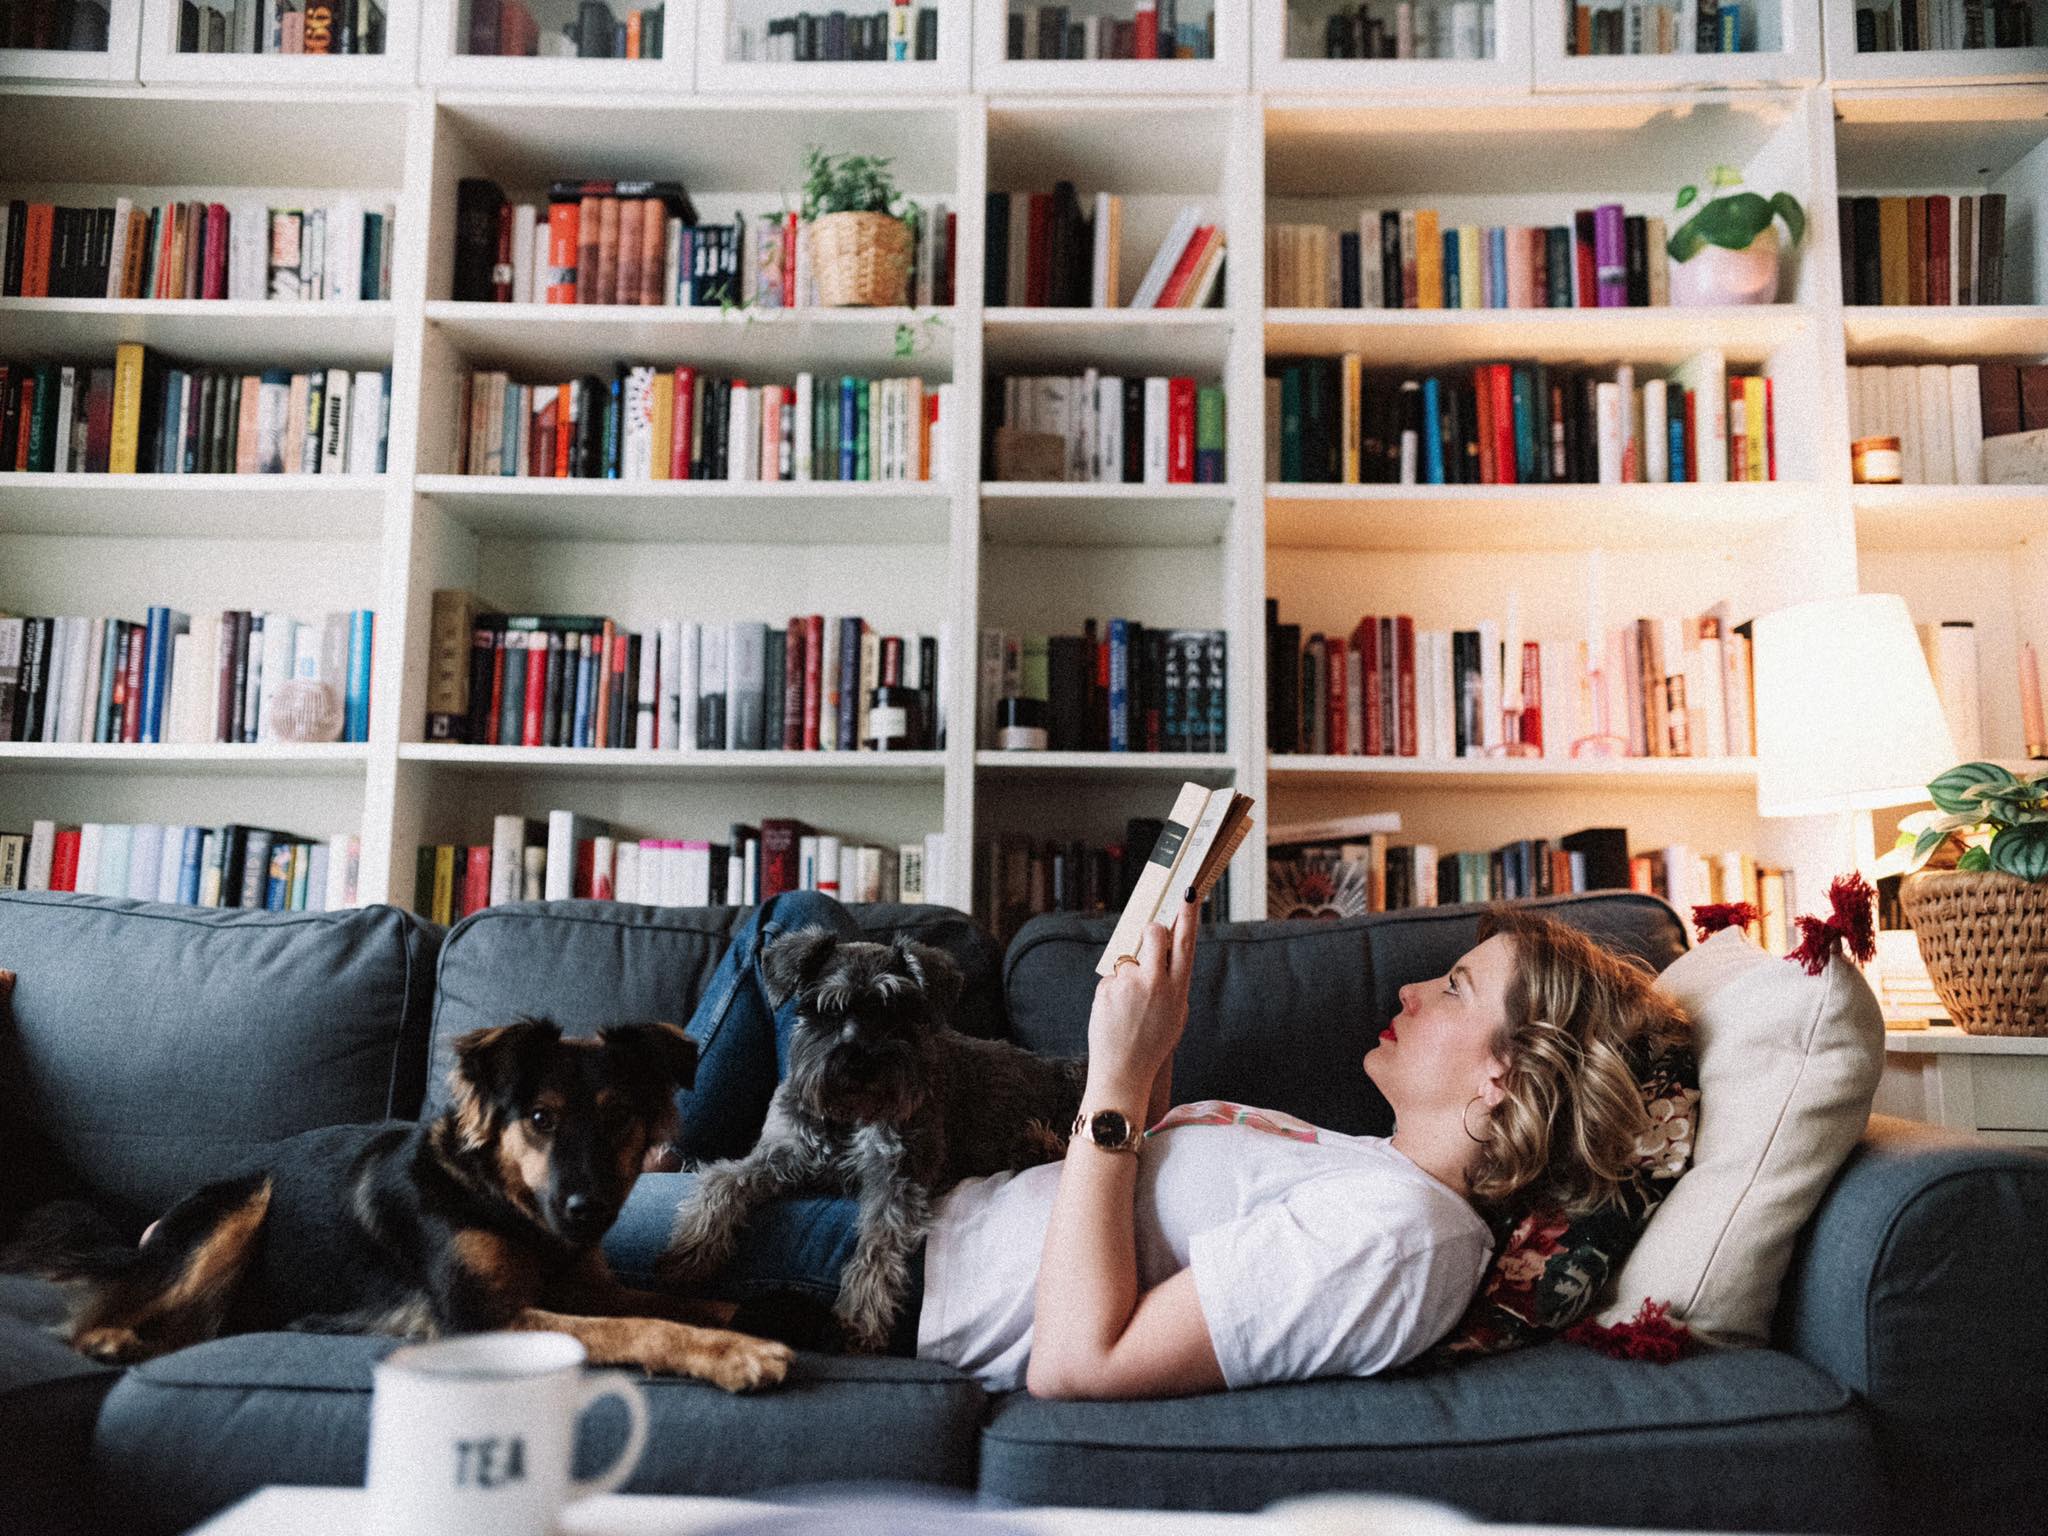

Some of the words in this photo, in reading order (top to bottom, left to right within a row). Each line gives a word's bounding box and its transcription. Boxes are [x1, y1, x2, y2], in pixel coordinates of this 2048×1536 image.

[24, 621, 36, 662] Gavalda
[20, 665, 30, 692] Anna
[456, 1436, 525, 1488] TEA
